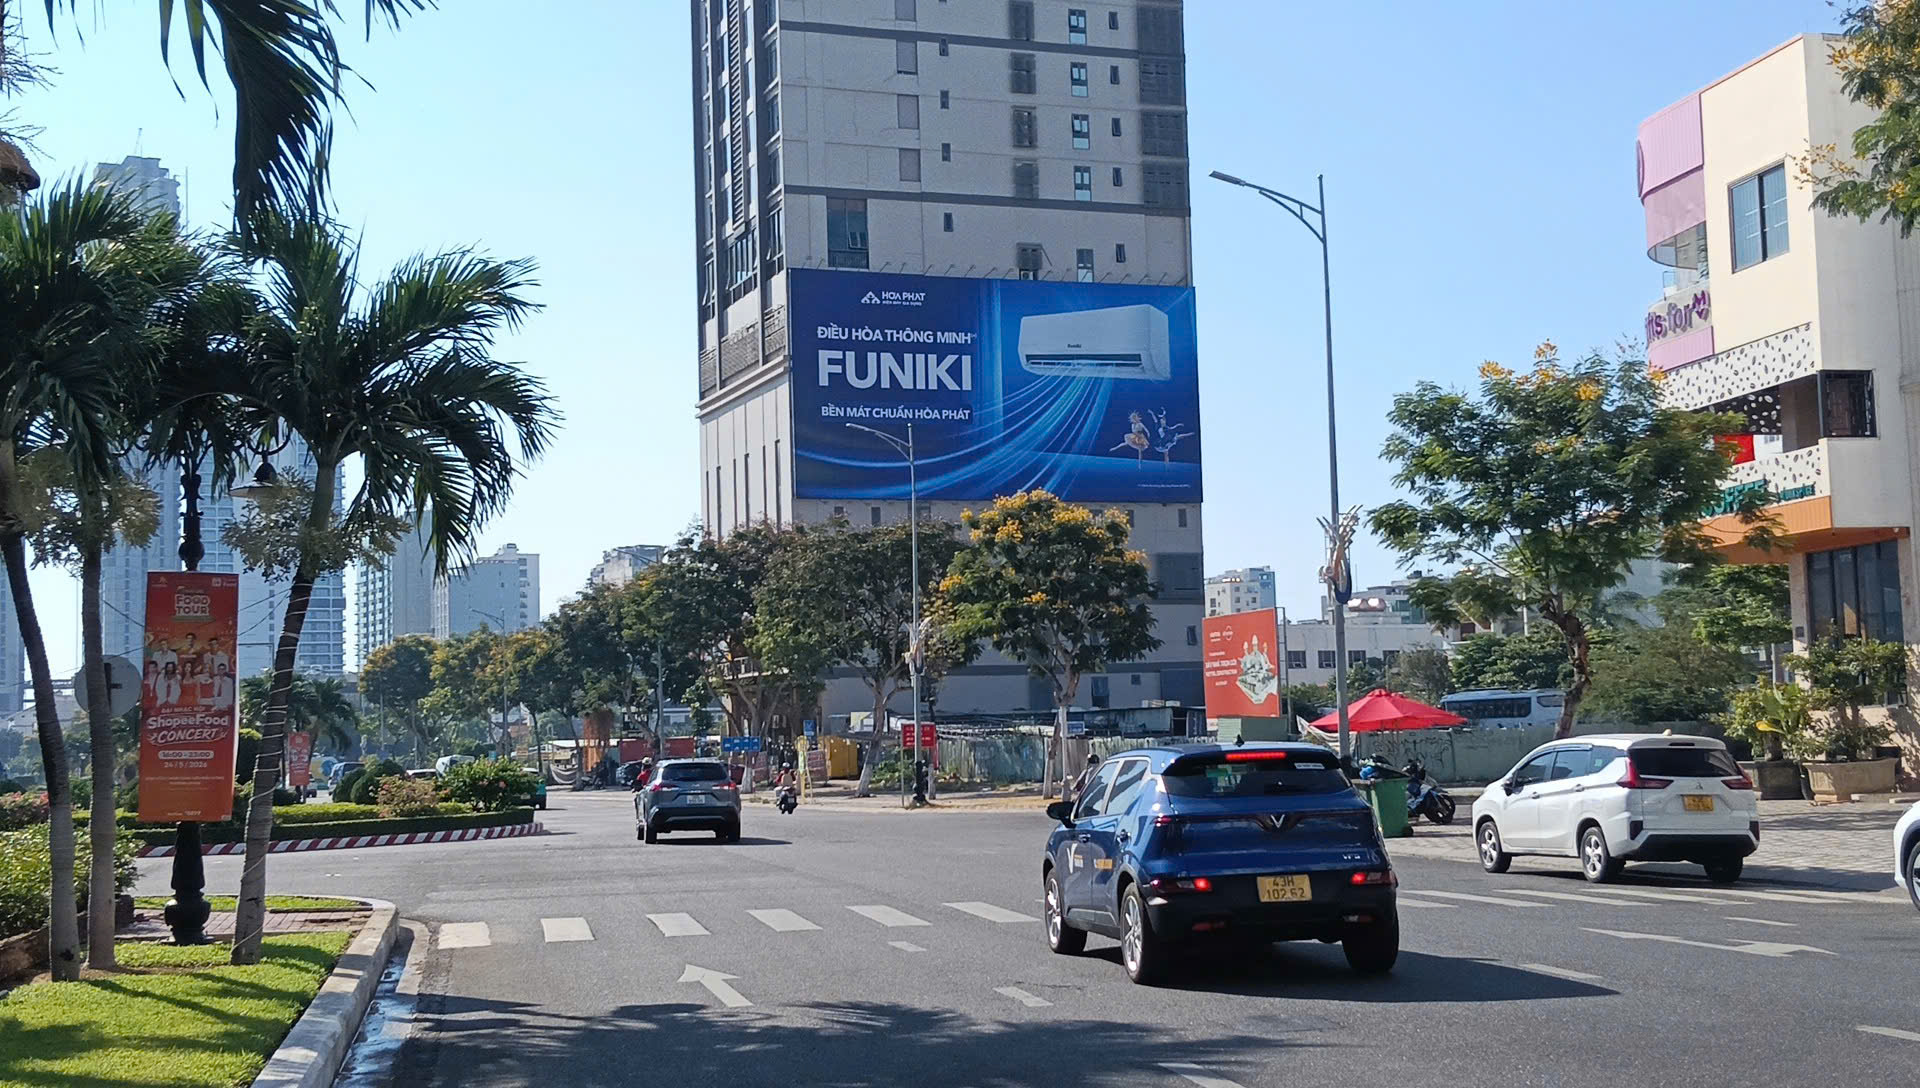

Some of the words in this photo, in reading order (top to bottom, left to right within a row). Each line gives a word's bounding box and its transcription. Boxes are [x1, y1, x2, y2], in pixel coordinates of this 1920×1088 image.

[817, 323, 849, 340] ĐIỀU
[851, 326, 883, 342] HÒA
[884, 328, 934, 343] THÔNG
[818, 349, 972, 391] FUNIKI
[821, 403, 845, 417] BỀN
[846, 405, 871, 418] MÁT
[872, 405, 913, 419] CHUẨN
[914, 407, 941, 420] HÒA
[942, 408, 970, 420] PHÁT
[175, 595, 210, 606] FOOD
[175, 605, 210, 615] TOUR
[147, 713, 229, 730] ShopeeFood
[157, 728, 220, 744] CONCERT
